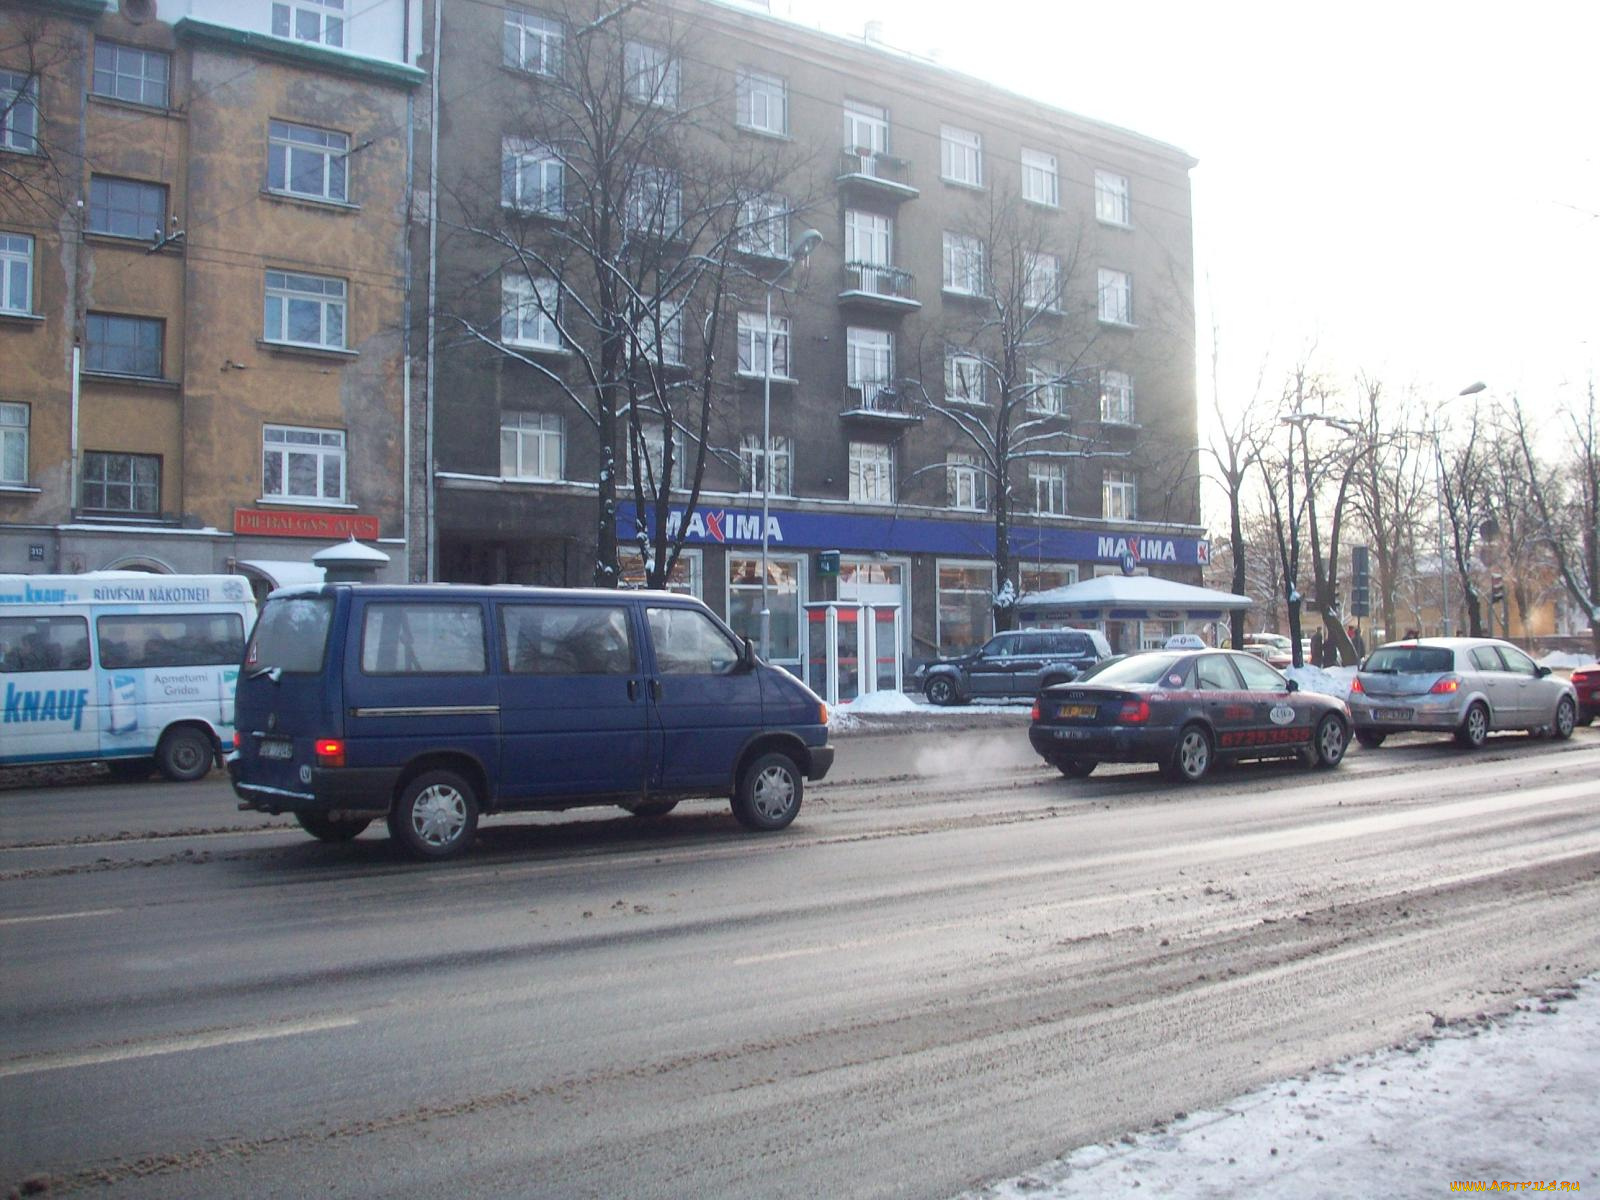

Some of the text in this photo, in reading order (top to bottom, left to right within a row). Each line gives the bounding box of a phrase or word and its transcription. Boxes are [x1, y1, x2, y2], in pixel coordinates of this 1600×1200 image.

[665, 510, 783, 542] MAXIMA
[1098, 536, 1177, 561] MAXIMA
[4, 682, 89, 731] KNAUF
